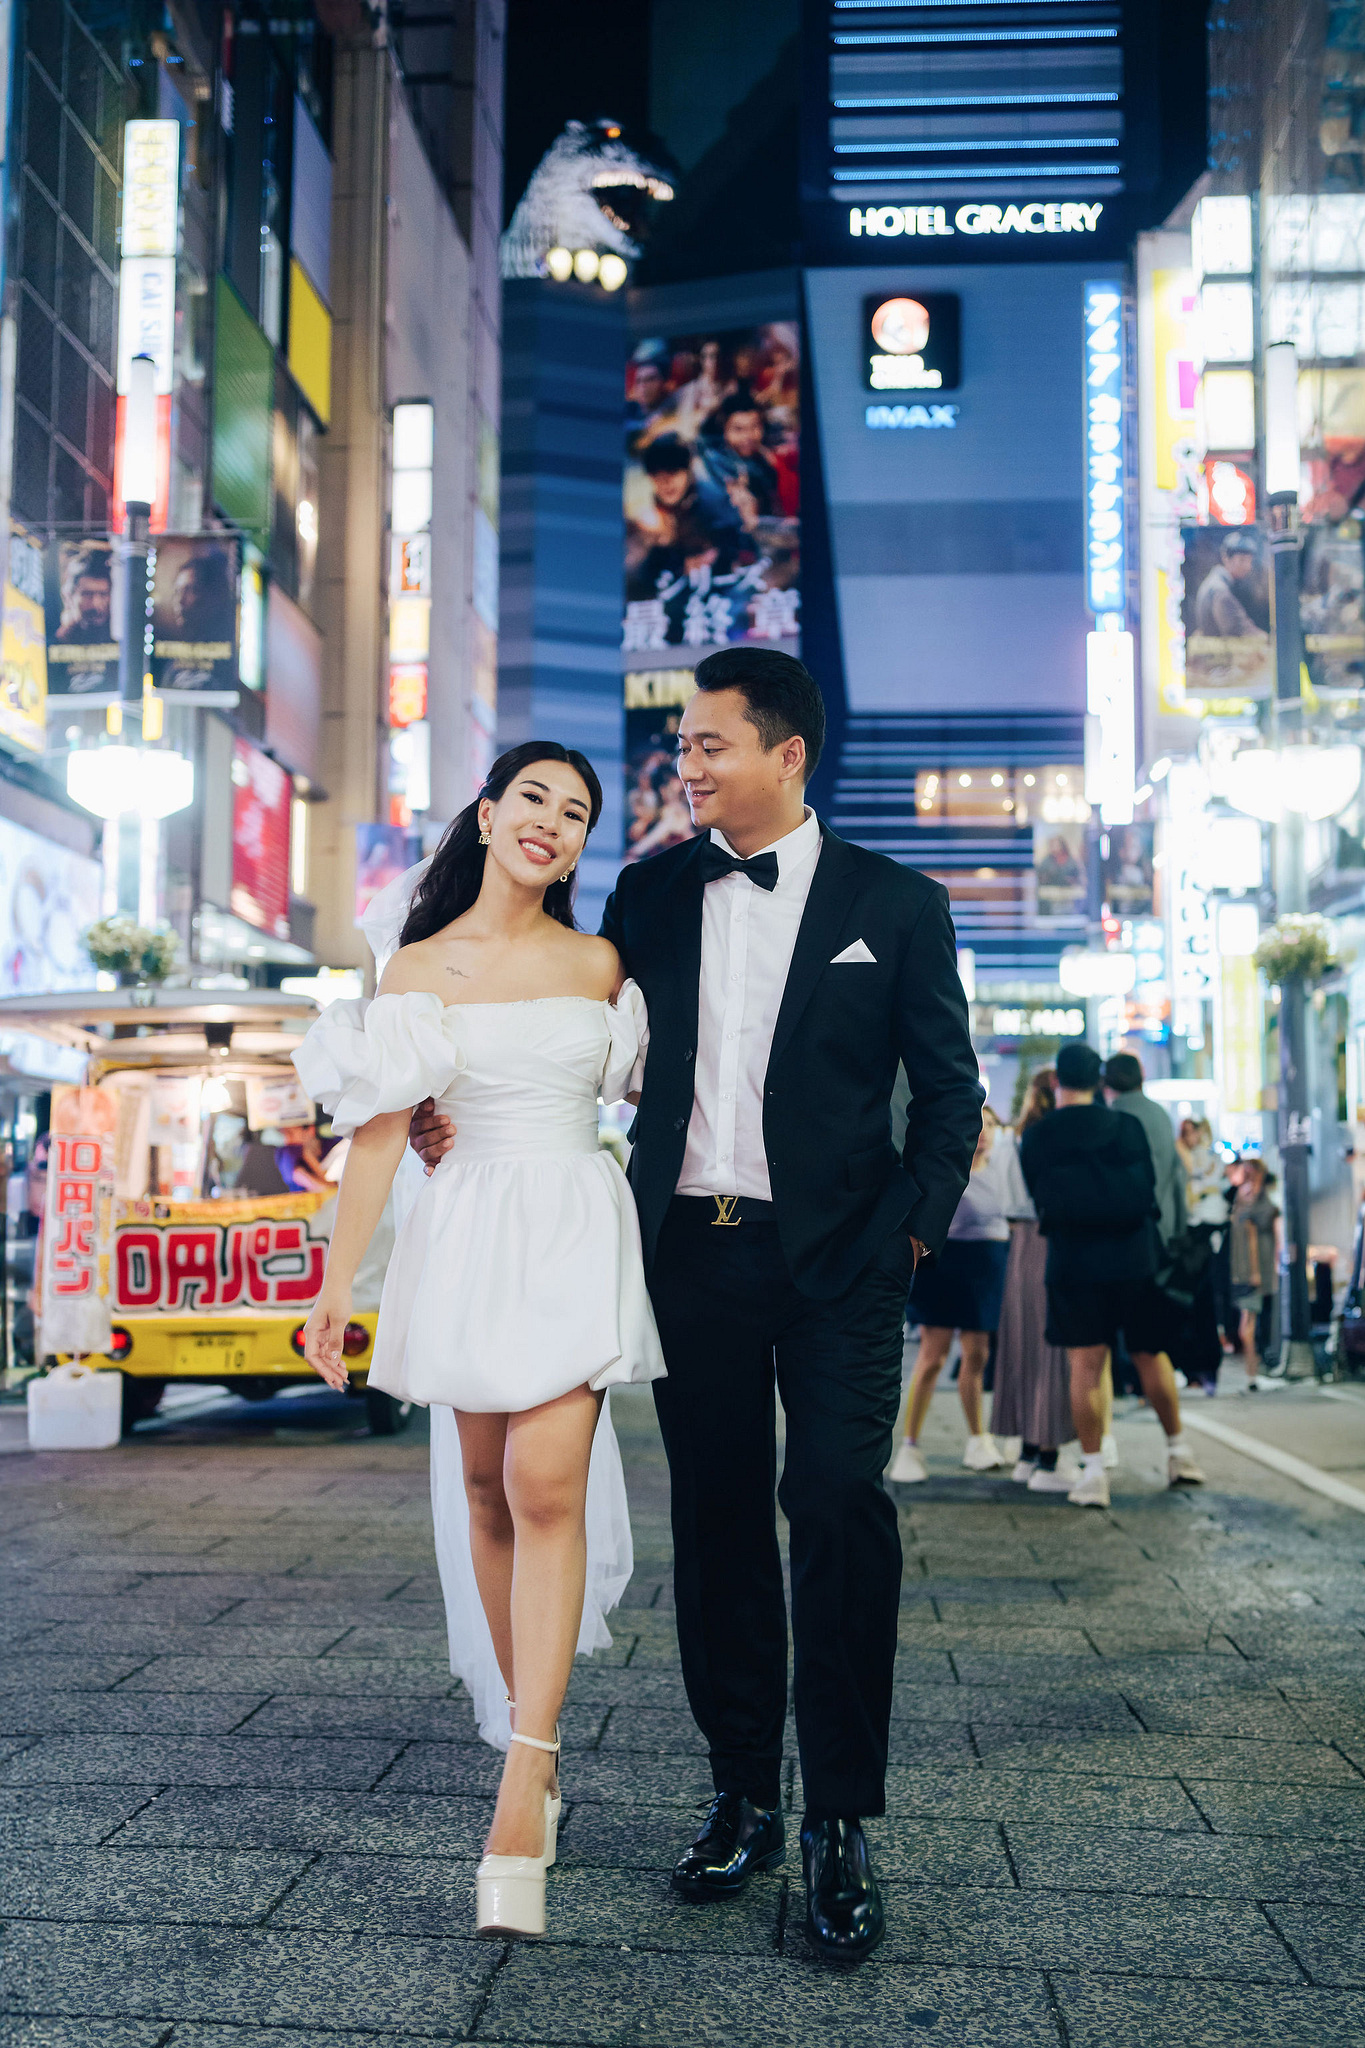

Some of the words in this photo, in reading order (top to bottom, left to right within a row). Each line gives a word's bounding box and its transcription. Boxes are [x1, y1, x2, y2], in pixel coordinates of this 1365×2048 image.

[849, 206, 955, 237] HOTEL
[955, 202, 1104, 235] GRACERY
[655, 556, 773, 600] シリーズ
[620, 587, 802, 652] 最終章
[54, 1140, 102, 1294] 10円パン
